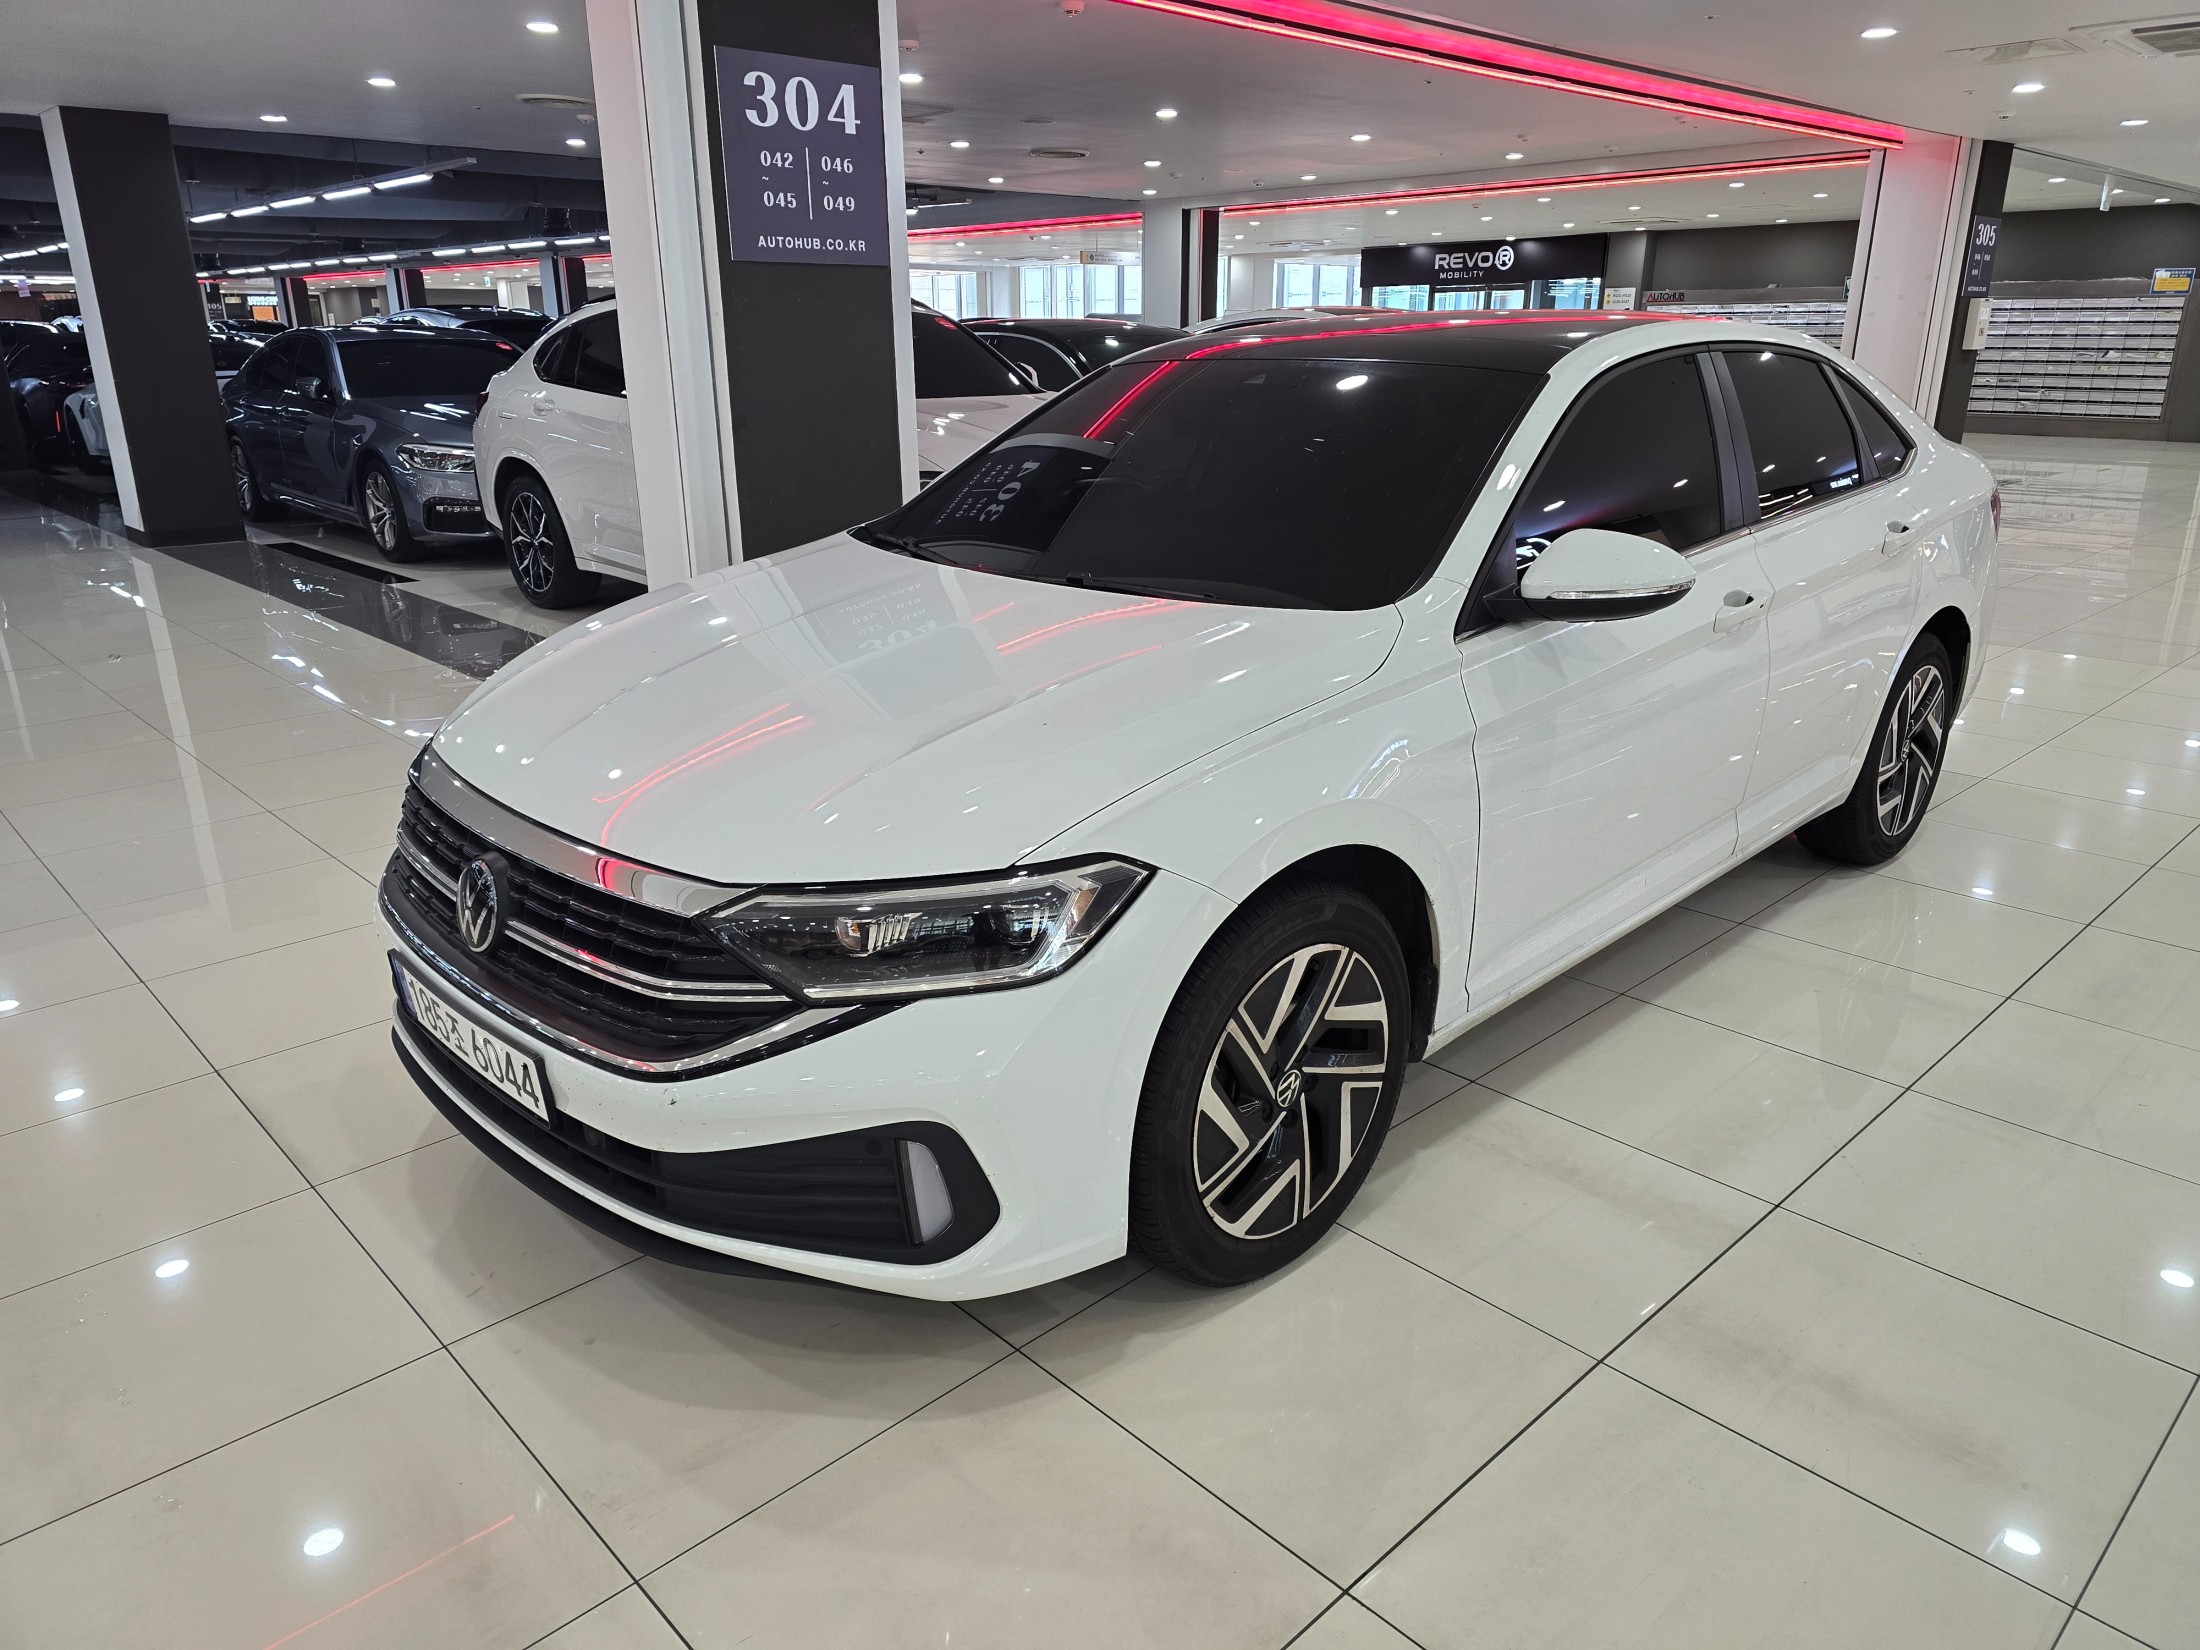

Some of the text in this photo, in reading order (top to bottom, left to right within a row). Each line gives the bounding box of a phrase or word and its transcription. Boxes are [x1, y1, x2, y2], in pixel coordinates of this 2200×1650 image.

[743, 71, 861, 135] 304
[760, 150, 794, 169] 042
[821, 155, 854, 174] 046
[763, 191, 797, 209] 045
[823, 195, 855, 212] 049
[758, 235, 866, 252] AUTOHUB.CO.KR
[1976, 223, 1997, 247] 305
[1439, 270, 1485, 279] MOBILITY
[1647, 292, 1685, 301] AUTOHUB
[409, 978, 540, 1109] 185조 6044
